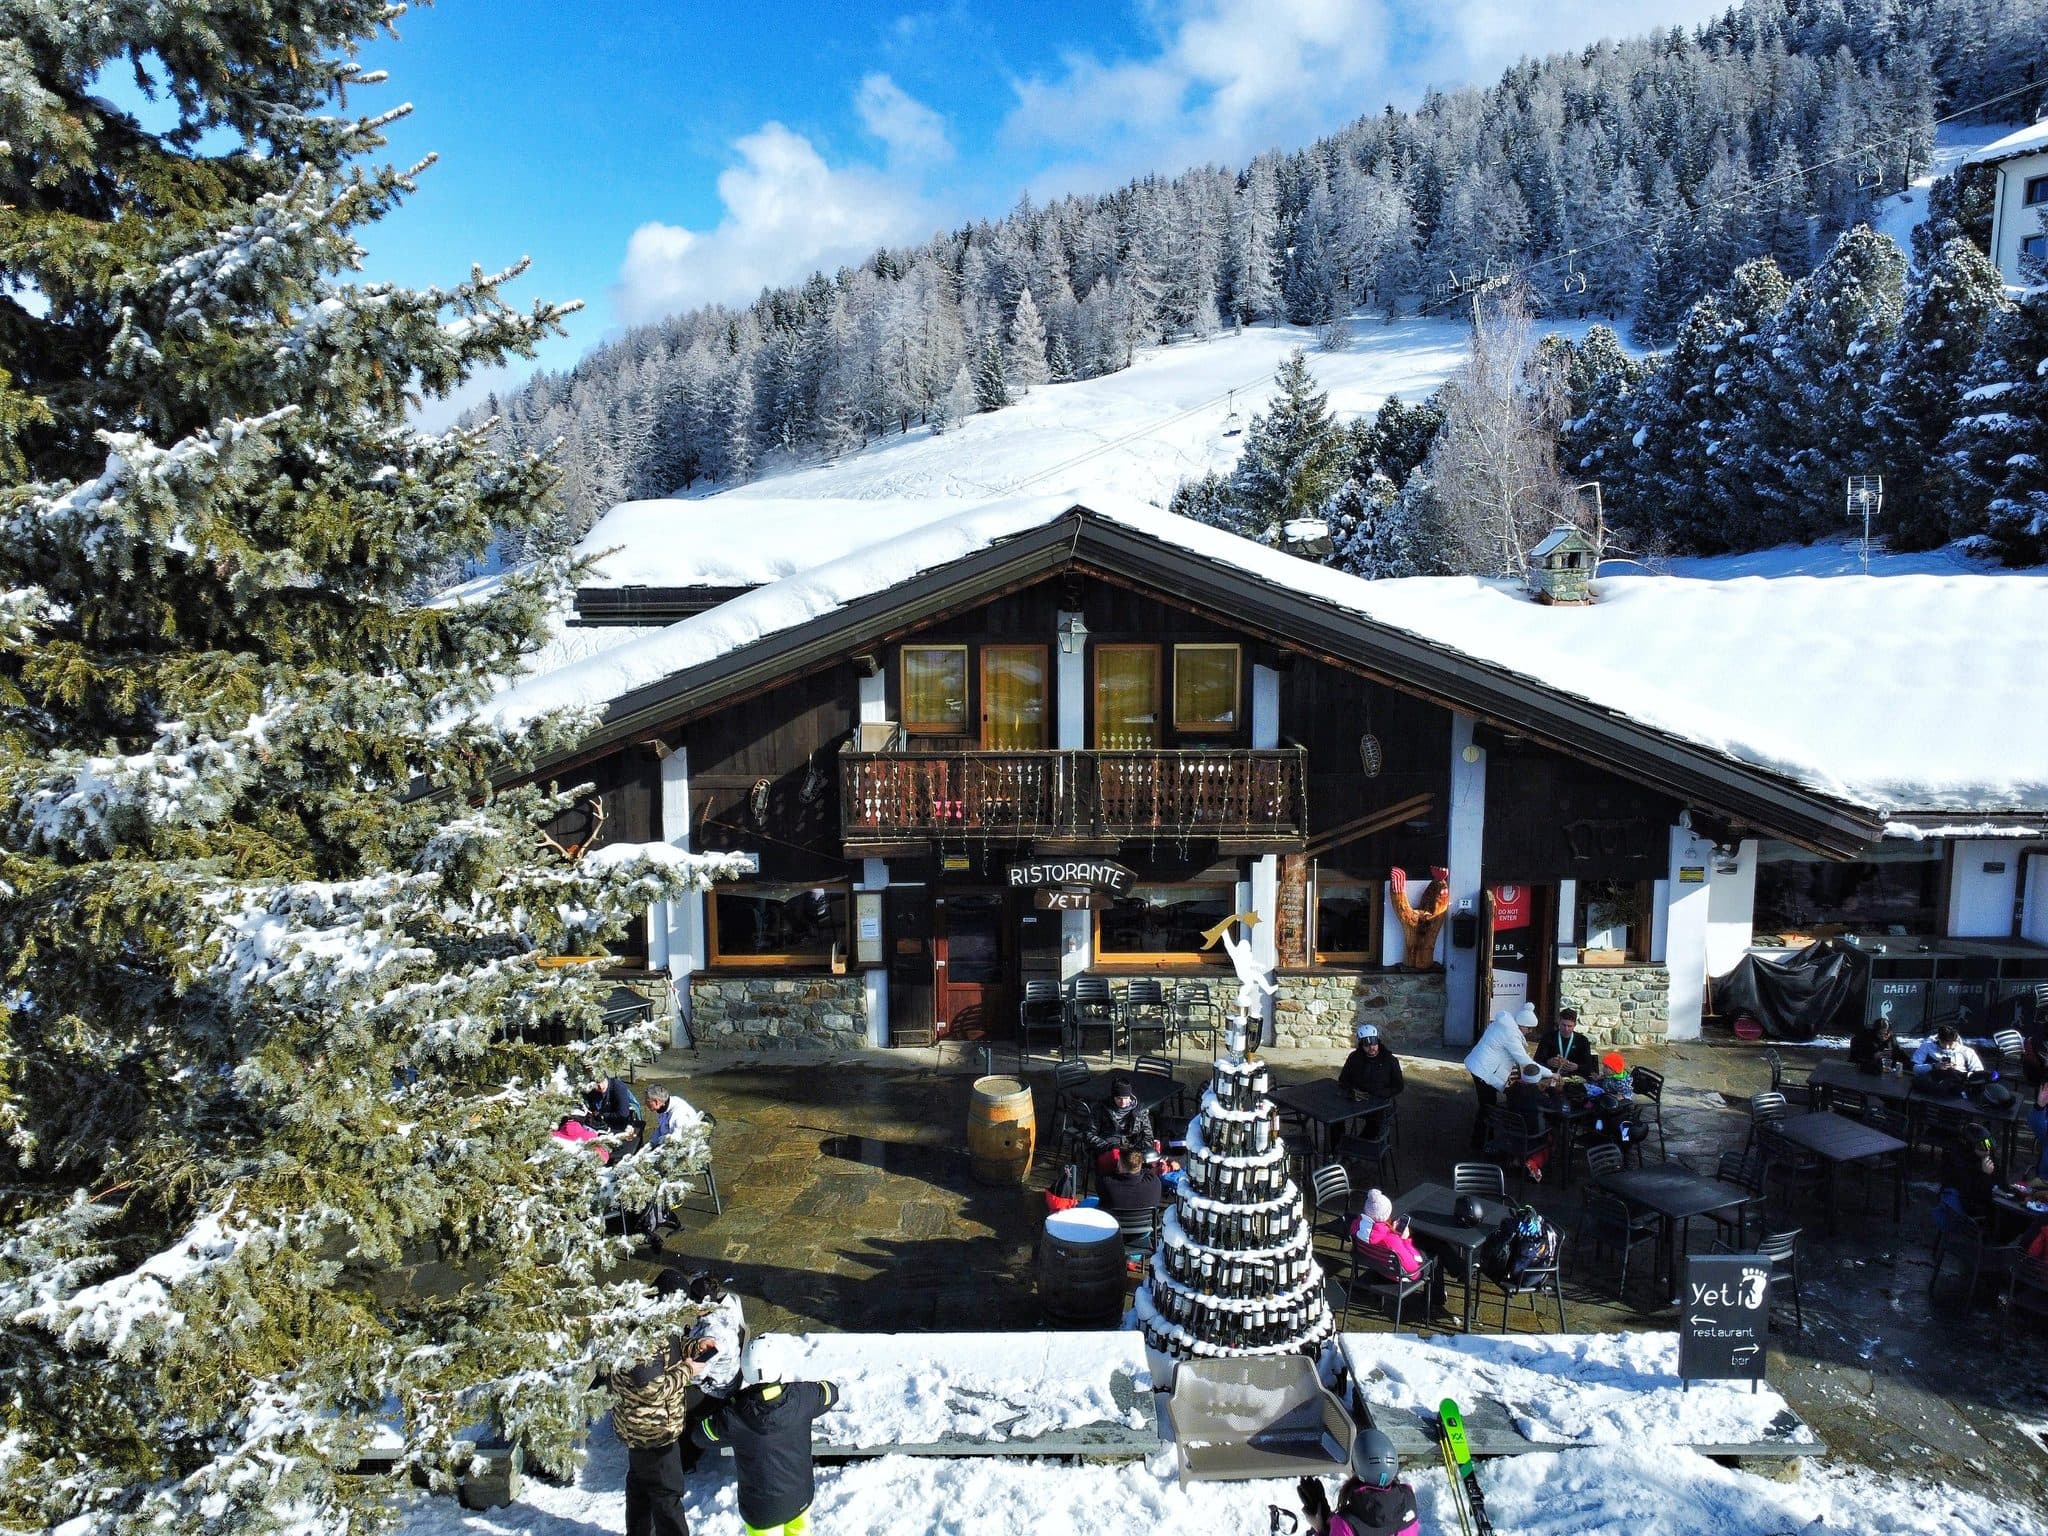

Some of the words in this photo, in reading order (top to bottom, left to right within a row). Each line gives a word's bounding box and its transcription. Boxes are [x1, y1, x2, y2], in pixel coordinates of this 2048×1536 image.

[1010, 863, 1125, 889] RISTORANTE
[1047, 892, 1090, 909] YETI
[1498, 908, 1507, 916] DO
[1507, 908, 1518, 916] NOT
[1883, 984, 1917, 994] CARTA
[1948, 984, 1982, 994] MISTO
[1693, 1327, 1755, 1338] restaurant
[1731, 1355, 1750, 1366] bar
